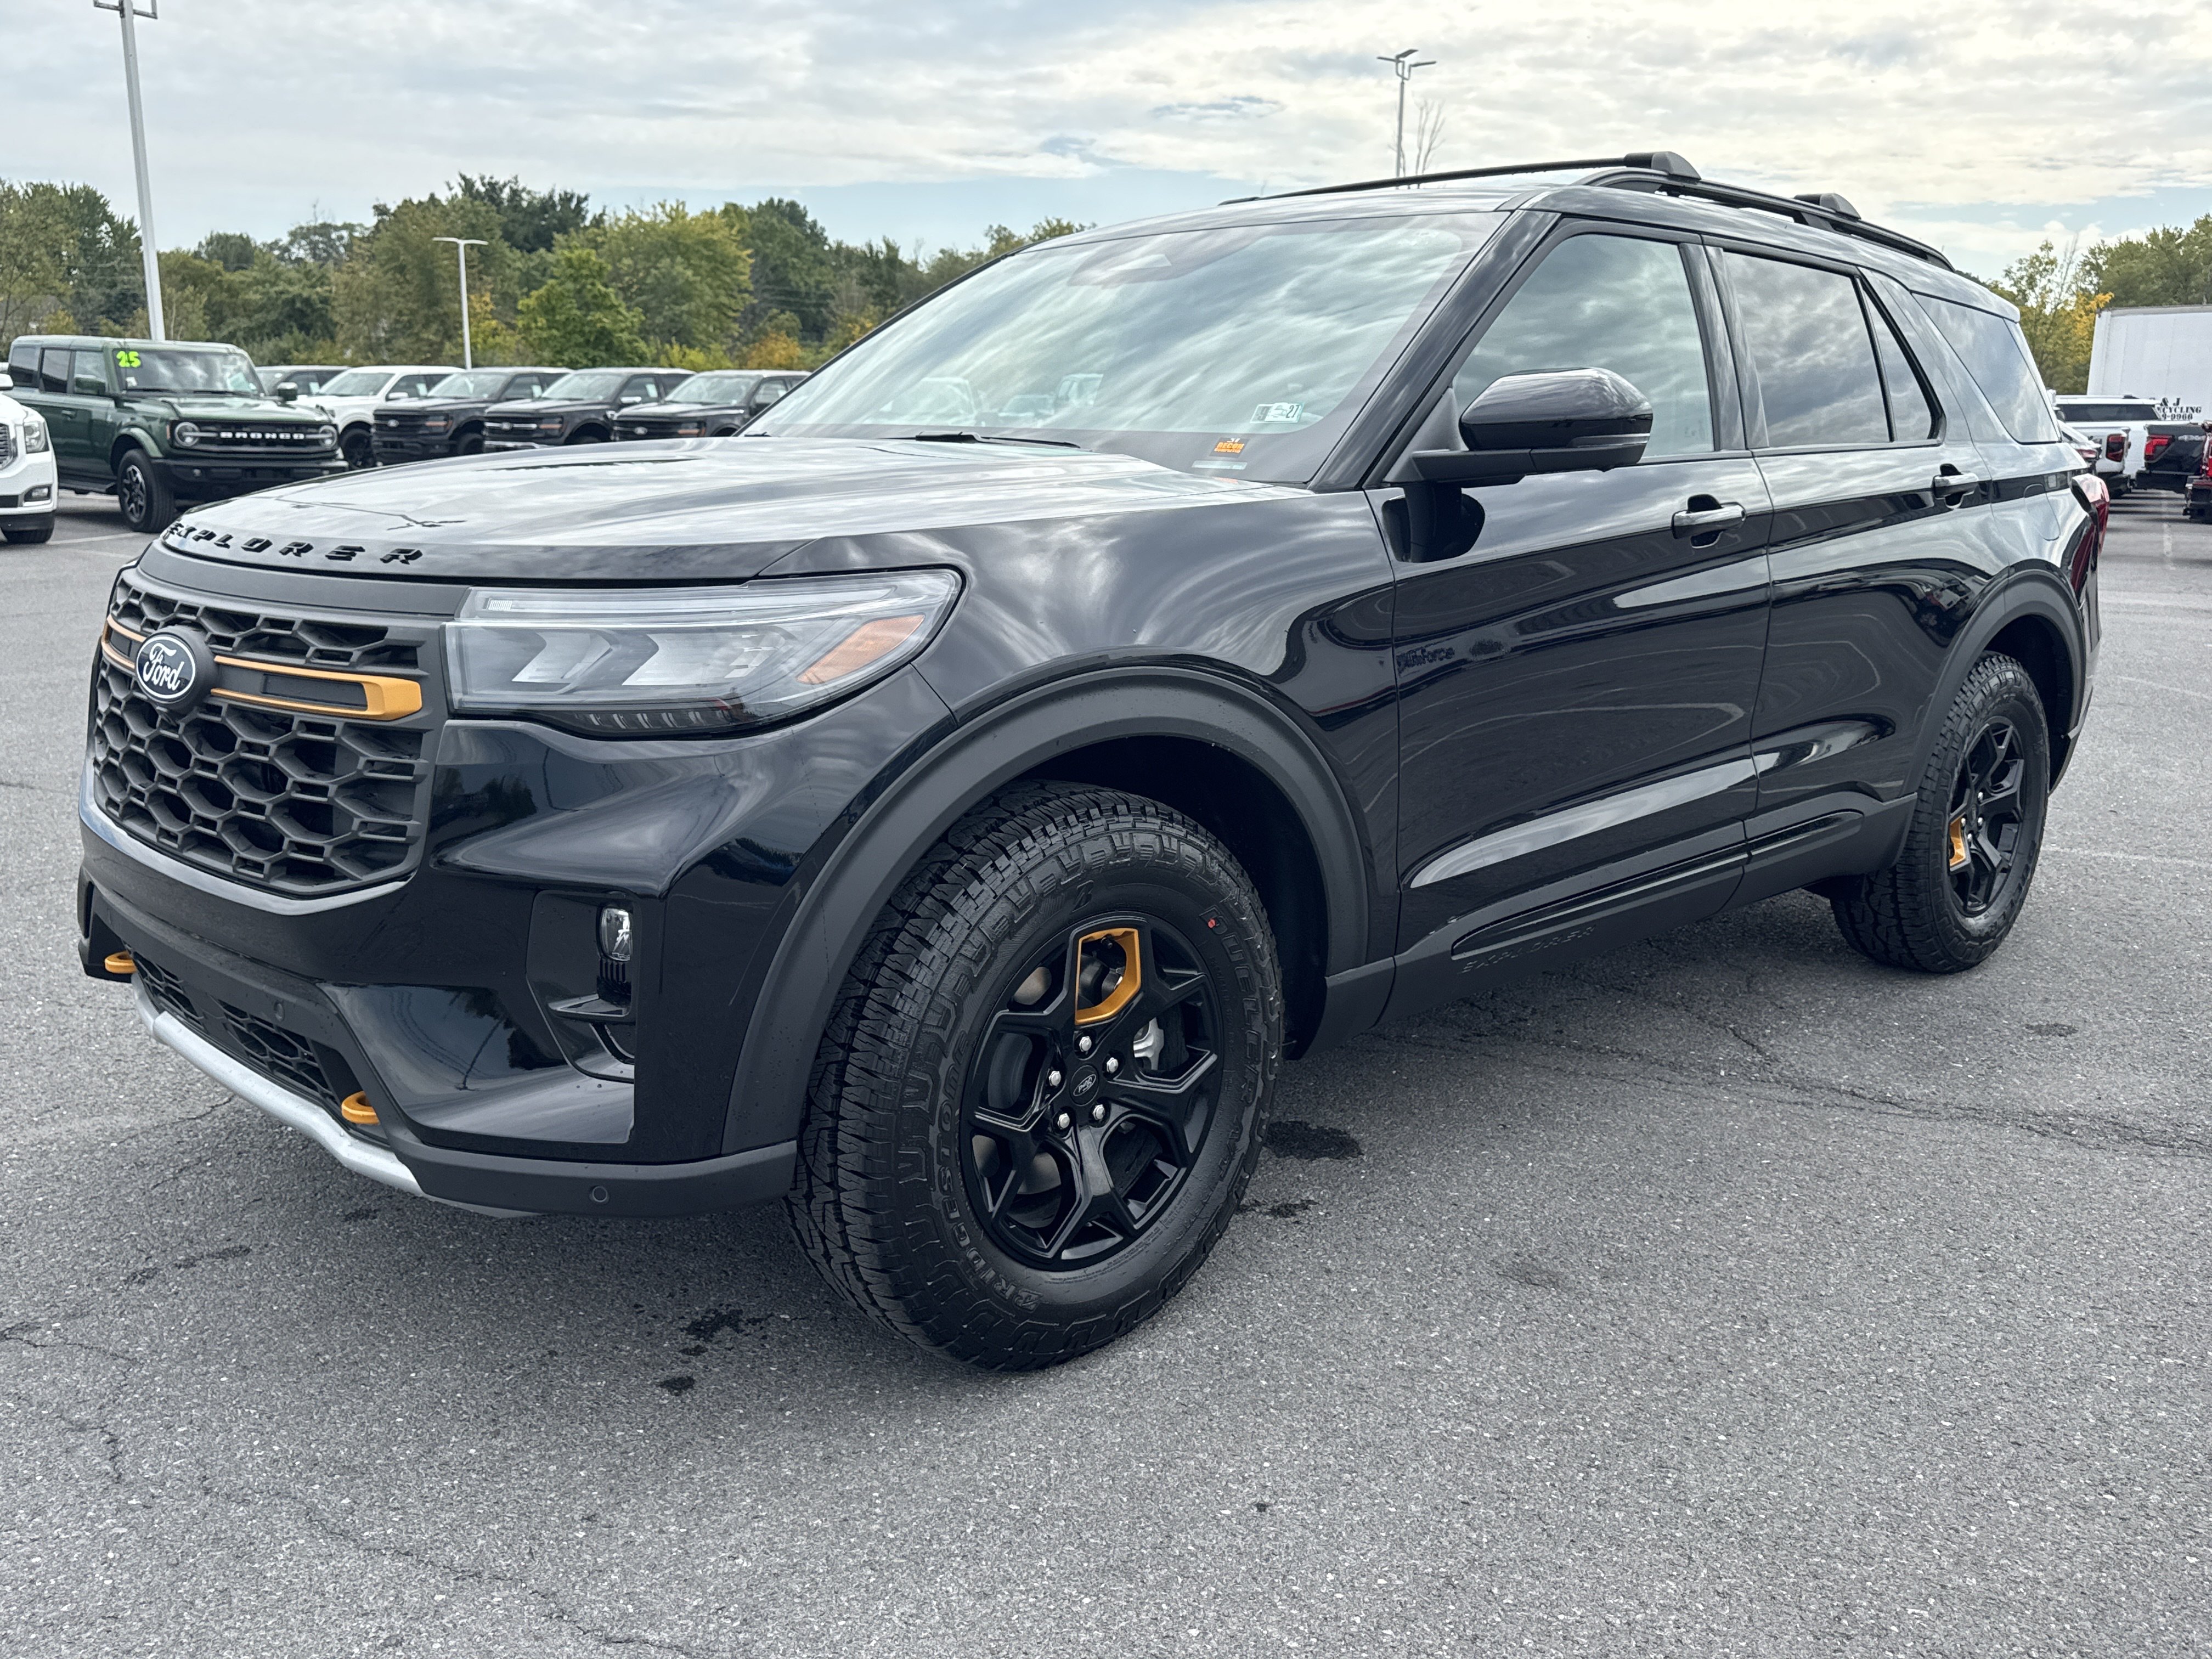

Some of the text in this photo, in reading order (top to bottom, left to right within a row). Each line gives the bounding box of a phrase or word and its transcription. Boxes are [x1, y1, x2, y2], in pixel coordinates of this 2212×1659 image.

[116, 351, 142, 368] 25
[1285, 404, 1302, 419] 27
[2172, 398, 2181, 406] J
[219, 431, 305, 439] BRONCO
[168, 522, 423, 566] EXPLORER
[143, 642, 185, 691] Ford
[1199, 904, 1260, 1107] DUELER
[937, 1030, 1043, 1312] BRIDGESTONE
